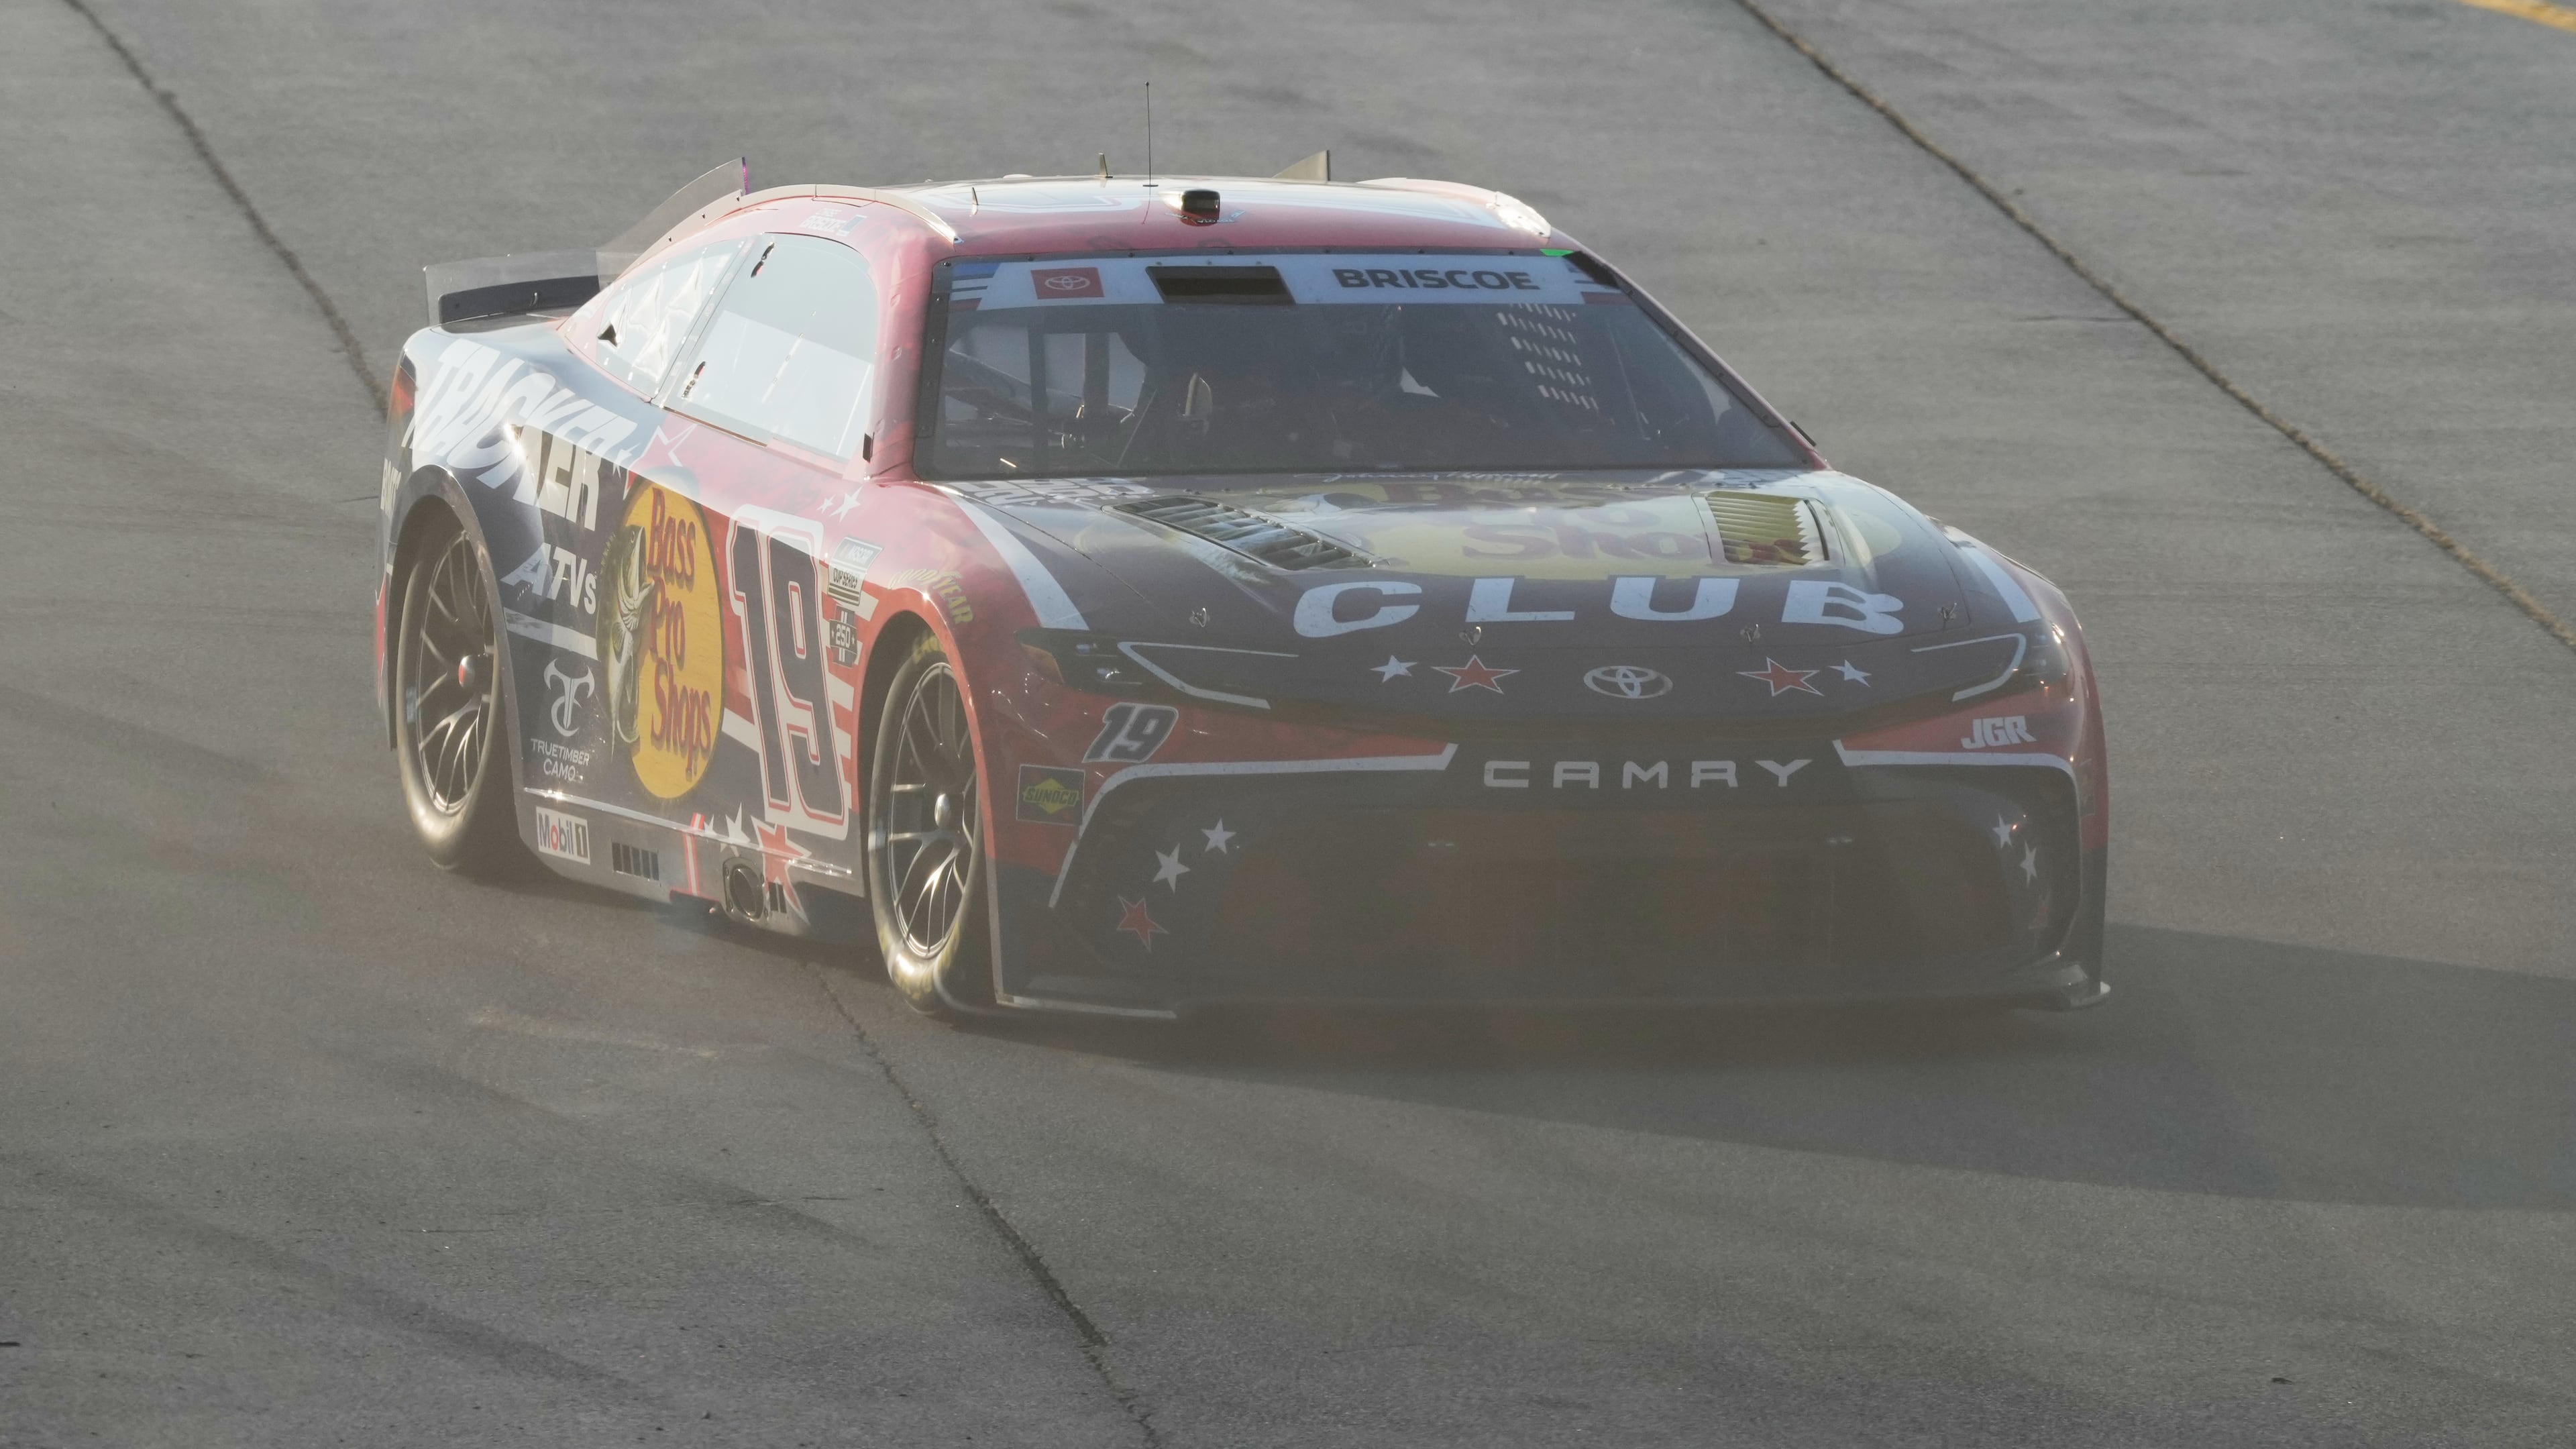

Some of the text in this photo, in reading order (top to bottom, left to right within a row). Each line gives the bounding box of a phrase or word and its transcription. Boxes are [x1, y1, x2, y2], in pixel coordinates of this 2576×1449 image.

[1332, 268, 1541, 290] BRISCOE
[401, 338, 638, 531] TRACKER
[647, 486, 698, 583] Bass
[500, 543, 598, 615] ATVs
[833, 568, 859, 589] CUP SERIES
[888, 568, 973, 624] GOODYEAR
[650, 578, 686, 669] Pro
[1293, 577, 1904, 637] CLUB
[836, 623, 851, 647] 250
[729, 508, 847, 822] 19
[651, 659, 712, 780] Shops
[1082, 702, 1179, 764] 19
[1960, 716, 2037, 750] JGR
[530, 737, 590, 767] TRUETIMBER
[543, 758, 576, 782] CAMO
[1483, 759, 1813, 790] CAMRY
[1023, 786, 1079, 806] SUNOCO
[538, 812, 574, 855] Mobil
